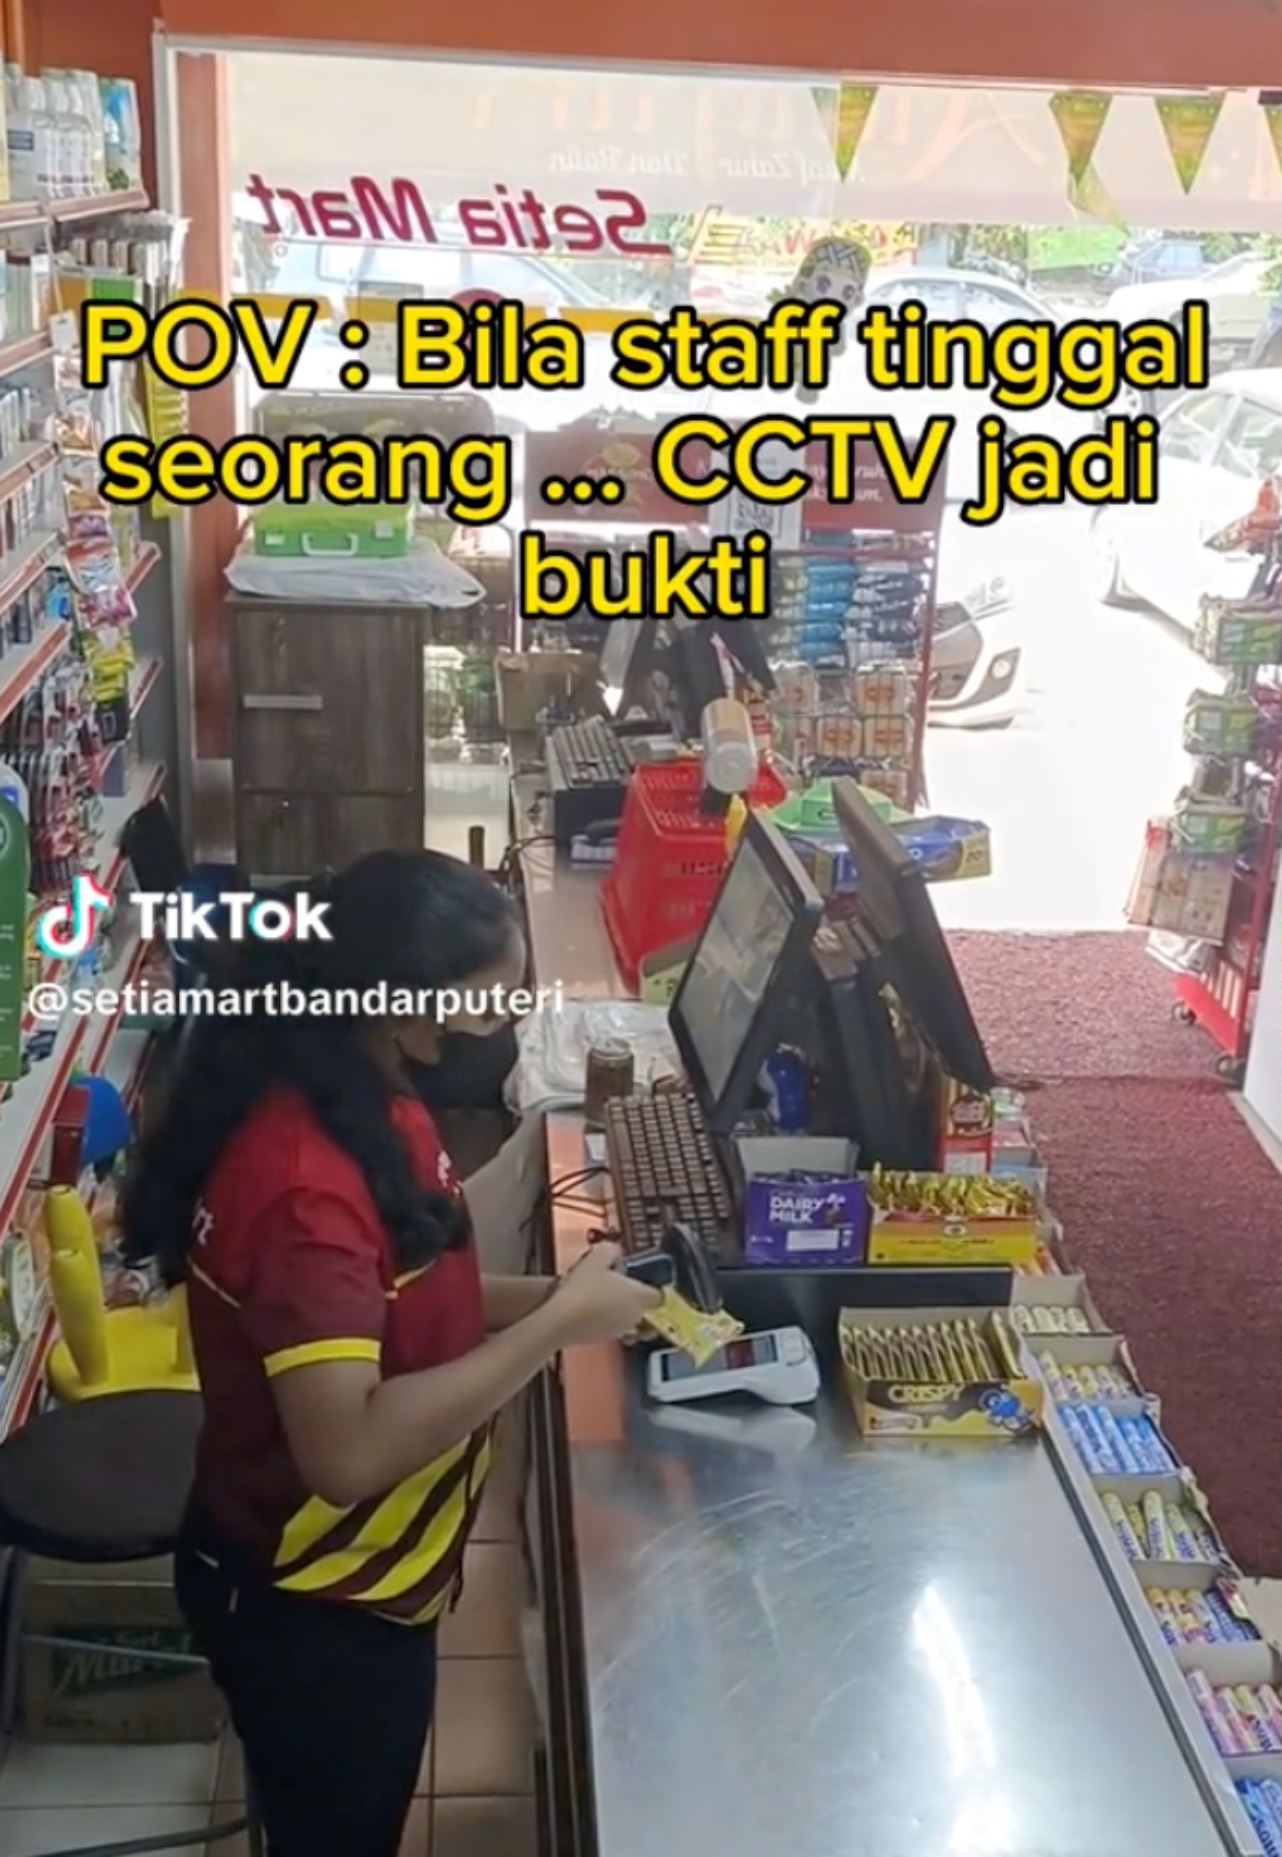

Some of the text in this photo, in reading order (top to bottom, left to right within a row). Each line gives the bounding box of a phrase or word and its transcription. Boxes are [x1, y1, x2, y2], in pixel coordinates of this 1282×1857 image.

[769, 1194, 826, 1212] DAIRY
[769, 1210, 813, 1225] MILK
[888, 1383, 966, 1403] CRISPY
